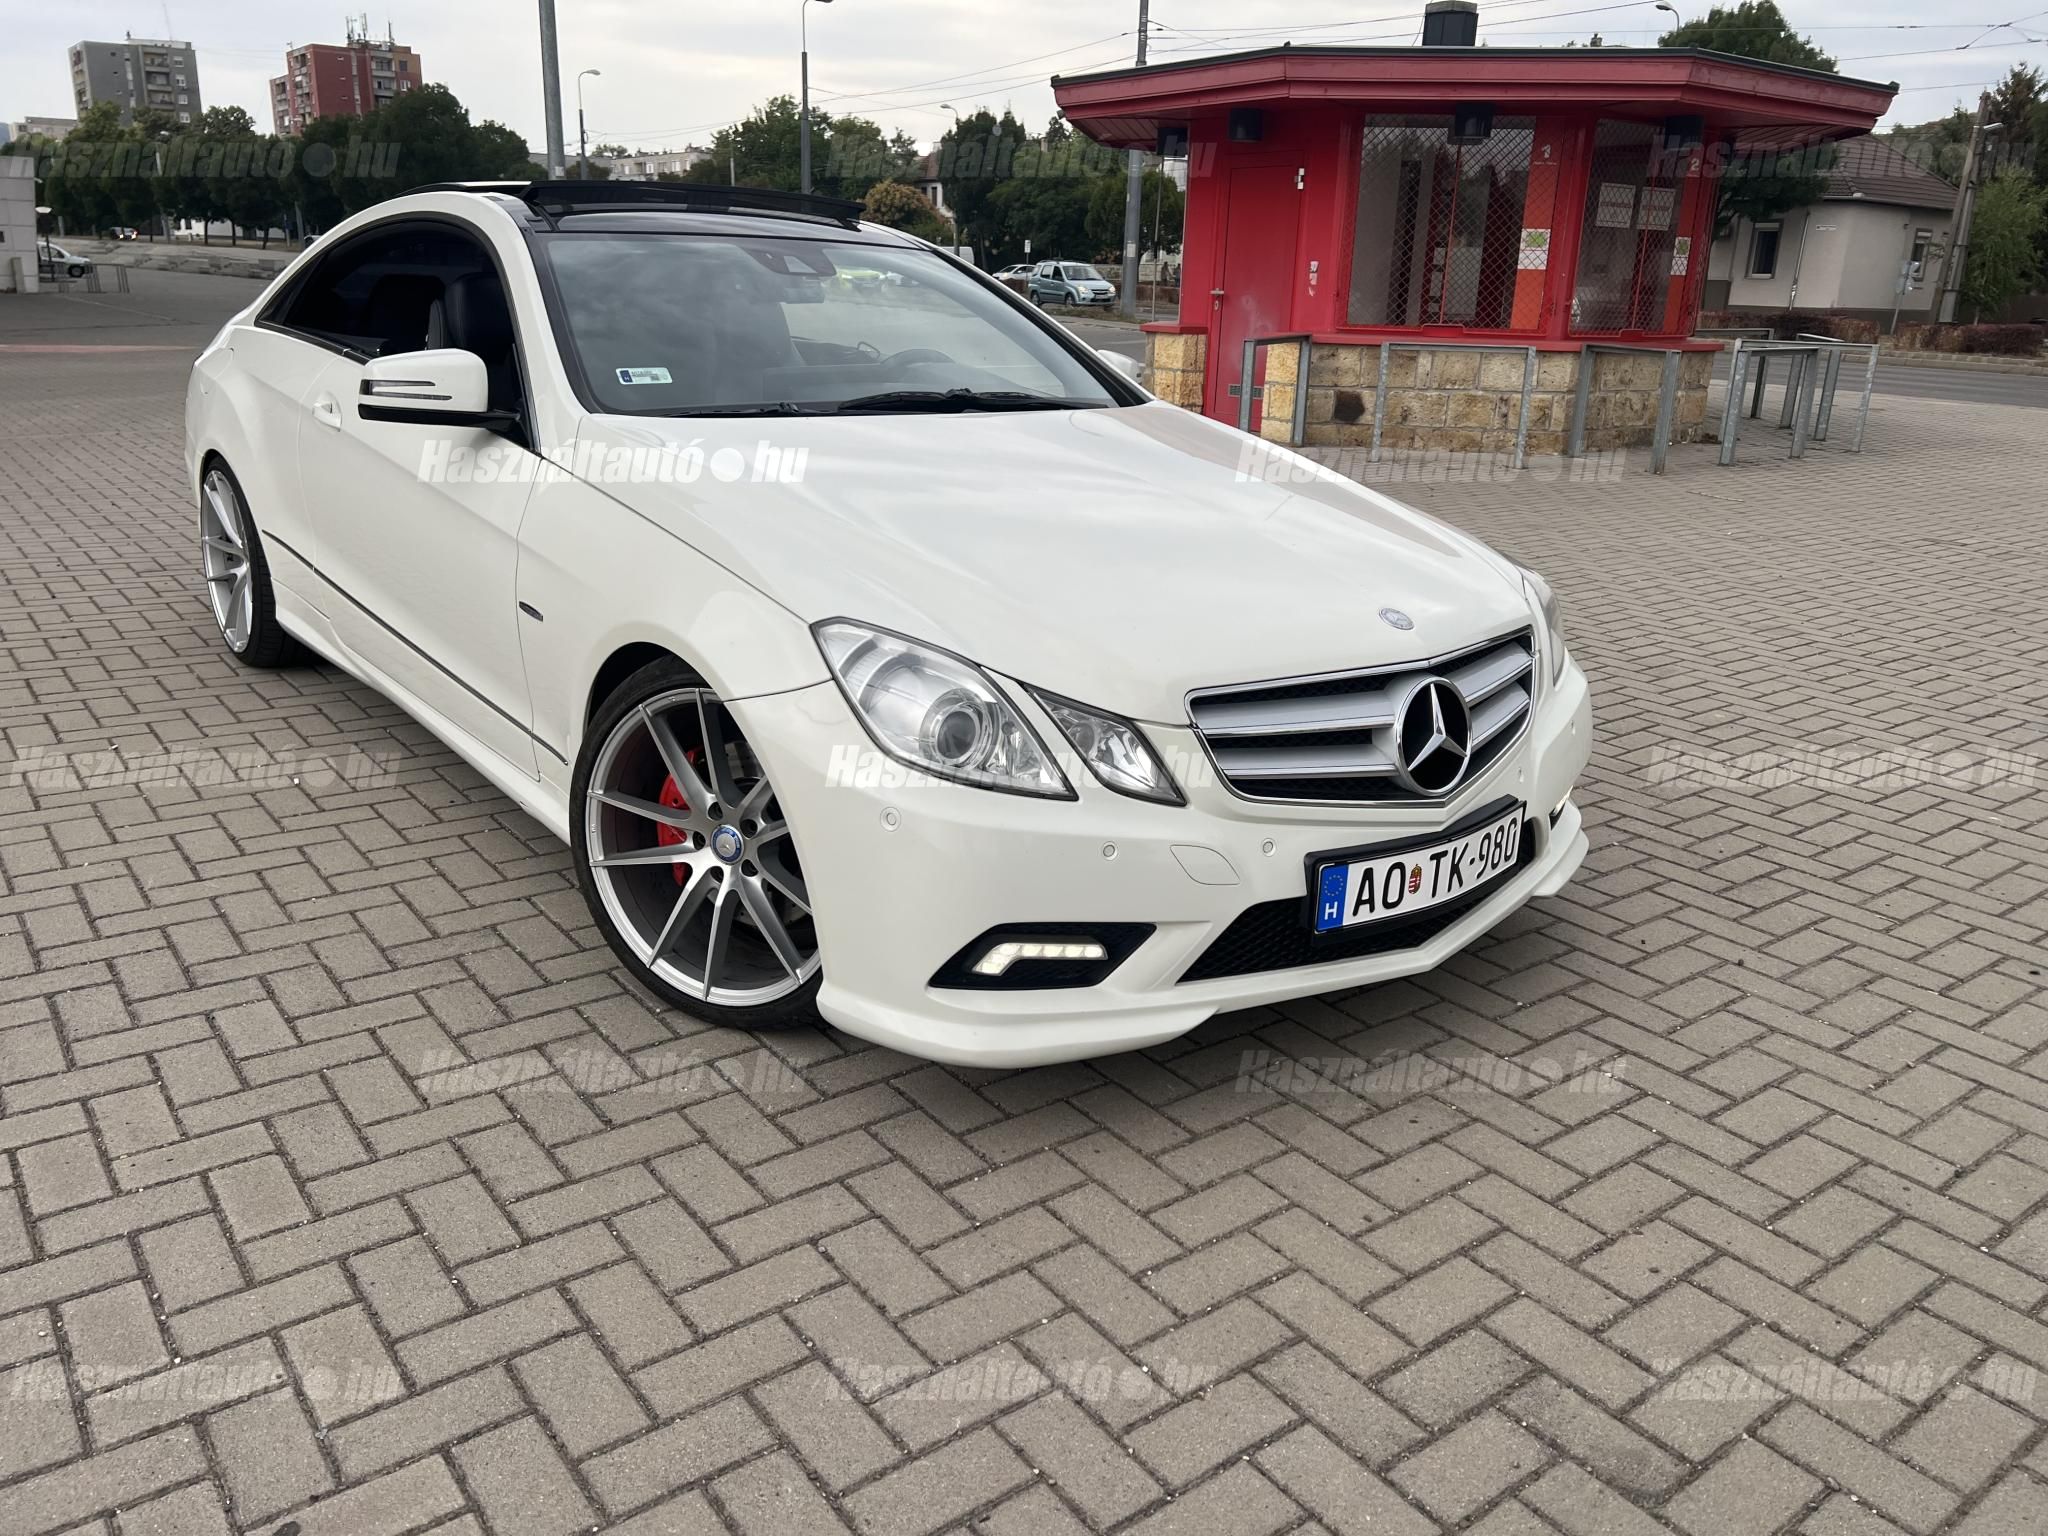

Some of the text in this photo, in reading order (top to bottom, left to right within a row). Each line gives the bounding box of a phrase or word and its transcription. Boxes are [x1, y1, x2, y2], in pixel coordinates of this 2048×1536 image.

[1690, 159, 1700, 171] 2
[1352, 861, 1406, 917] AO
[1324, 901, 1338, 920] H
